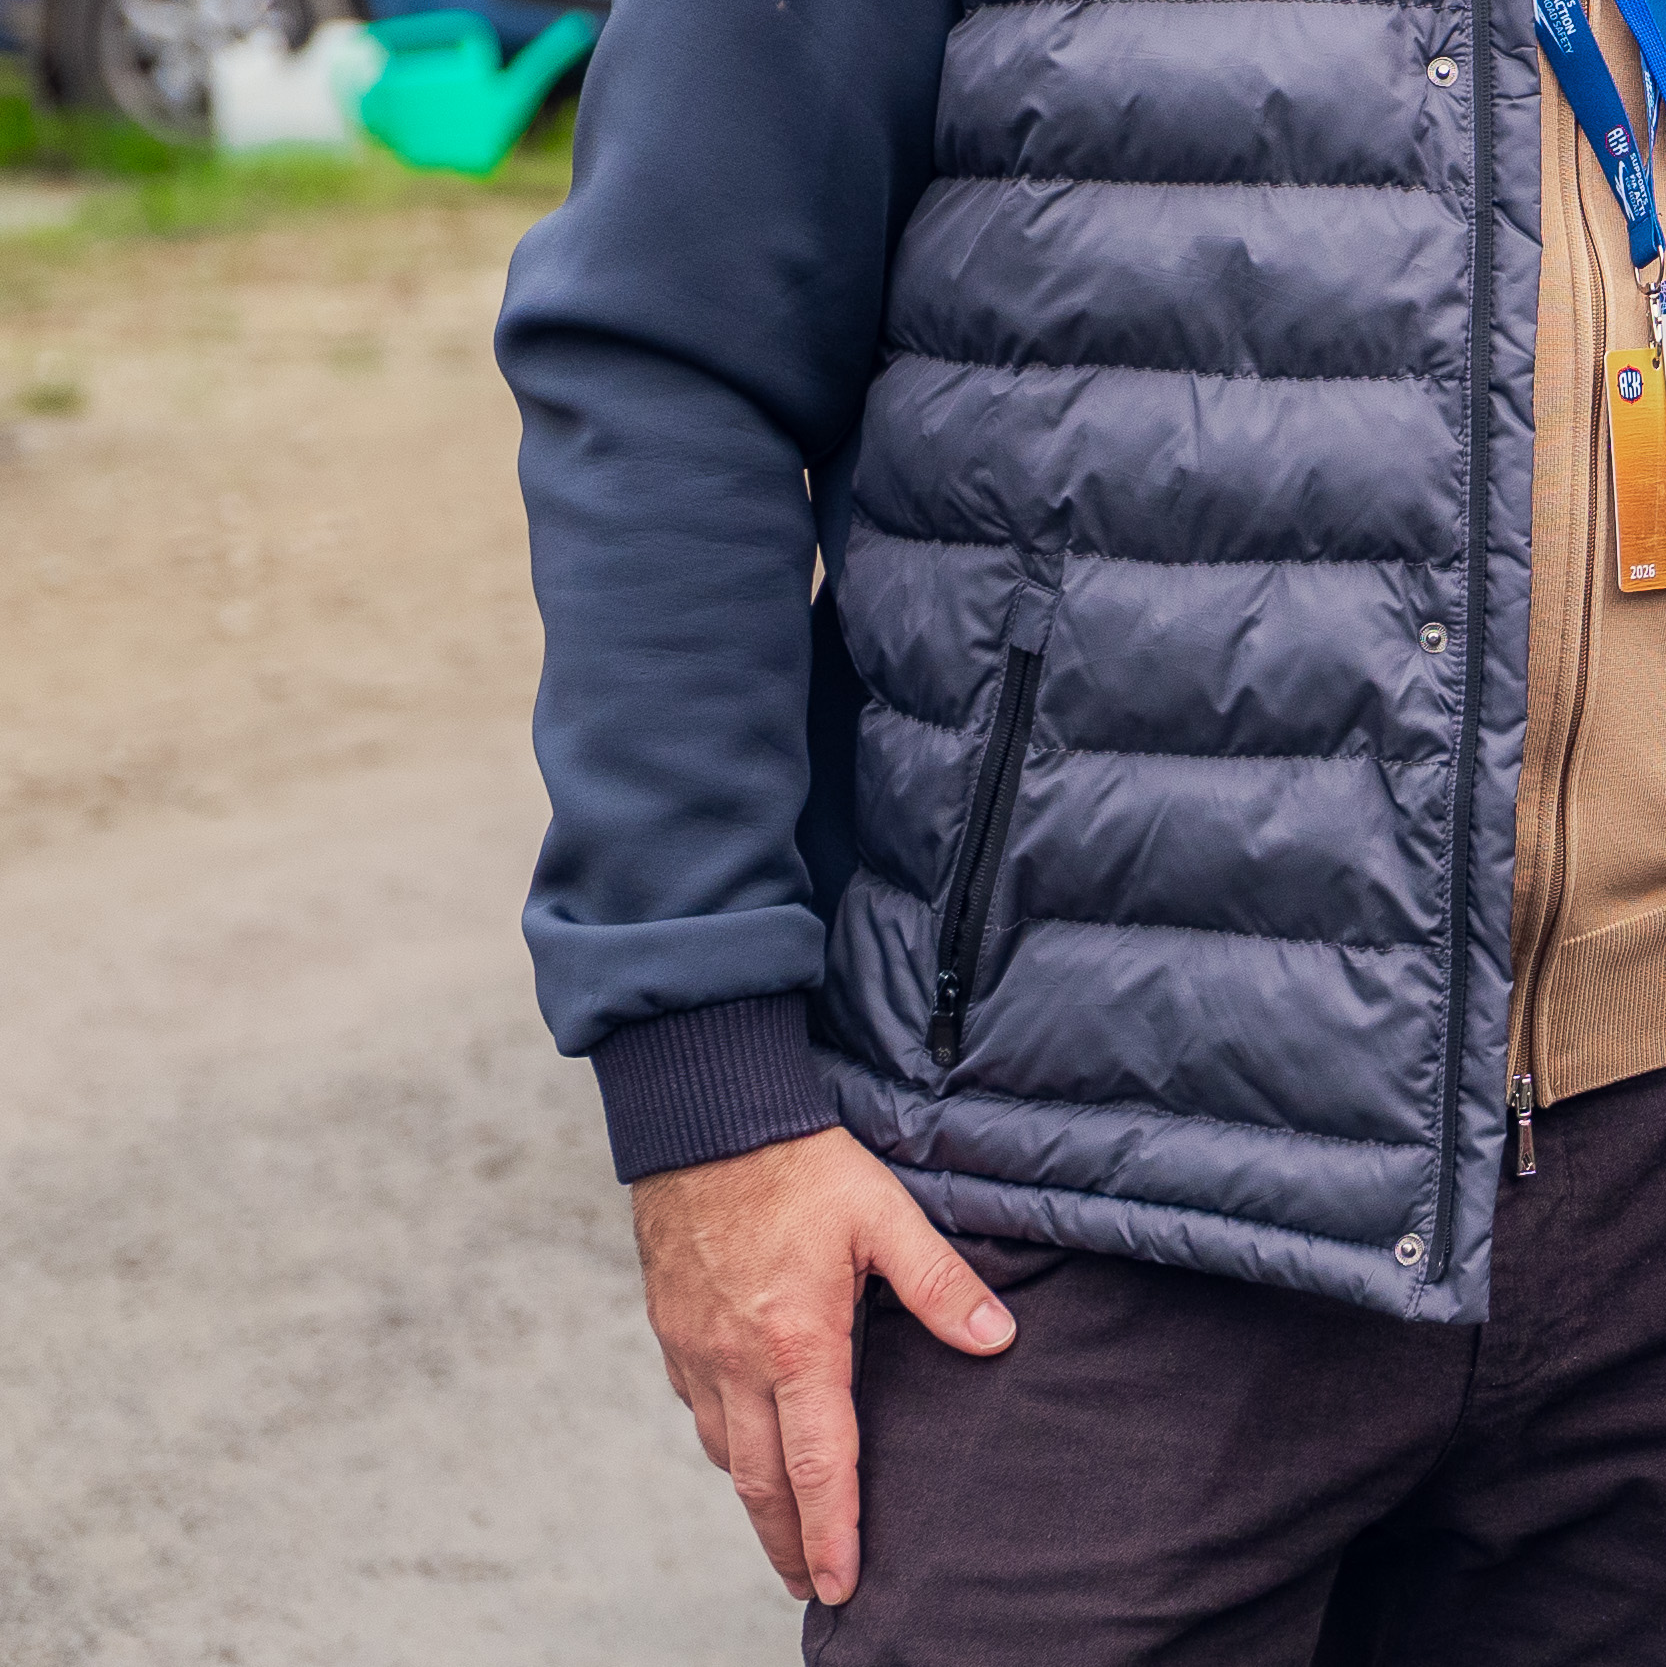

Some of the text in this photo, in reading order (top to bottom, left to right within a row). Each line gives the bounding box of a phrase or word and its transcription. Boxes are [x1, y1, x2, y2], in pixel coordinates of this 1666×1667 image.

[1552, 20, 1575, 53] SAFETY
[1607, 127, 1629, 156] AKK
[1629, 152, 1649, 206] SUPPORTS
[1633, 191, 1647, 217] ACTI
[1619, 371, 1642, 399] AKK
[1629, 563, 1656, 580] 2026
